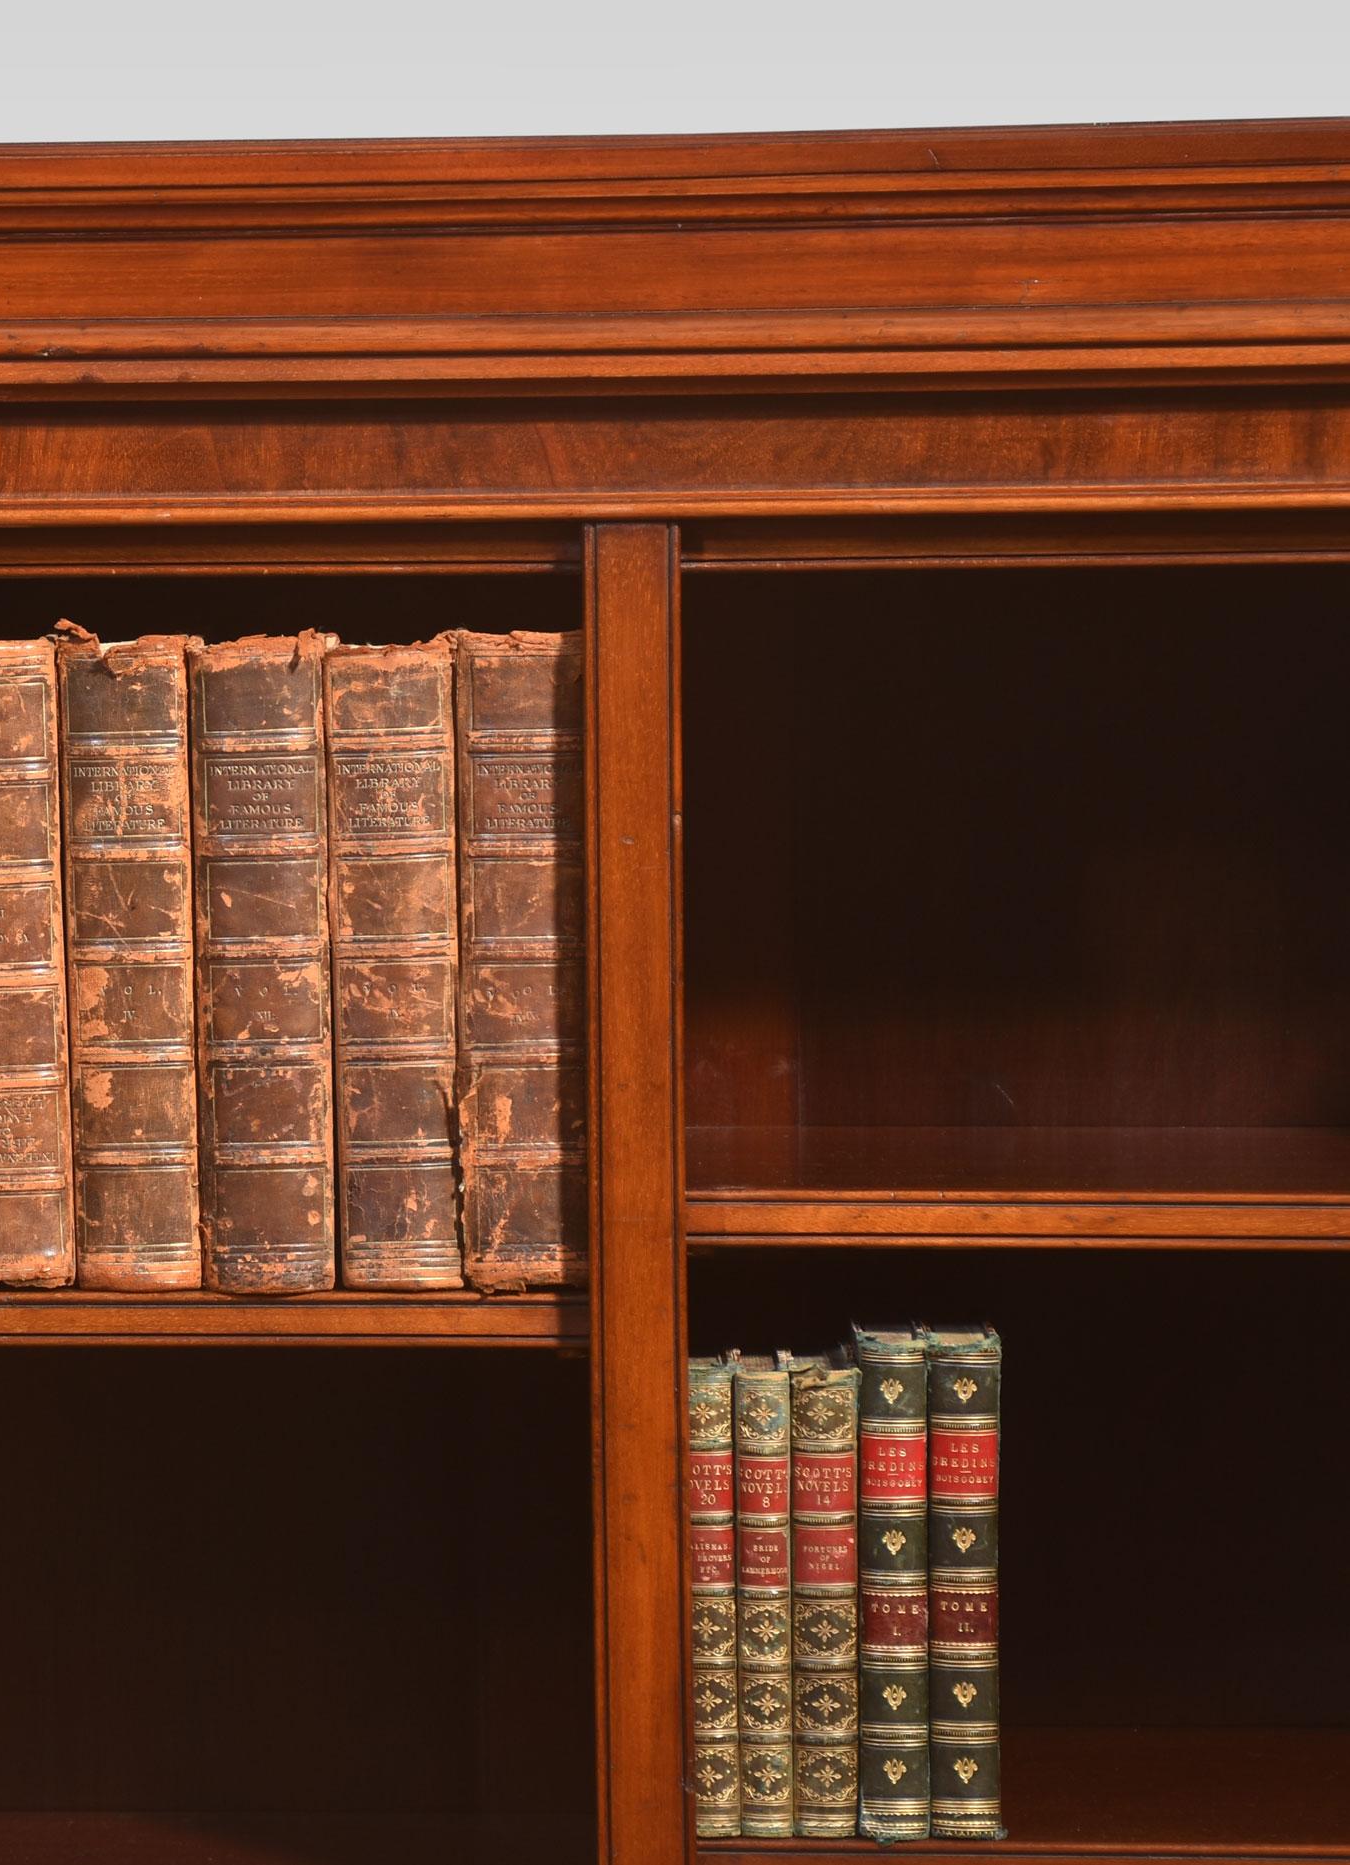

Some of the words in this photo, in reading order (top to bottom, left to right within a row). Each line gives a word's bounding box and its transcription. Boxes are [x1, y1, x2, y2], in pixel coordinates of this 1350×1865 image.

[209, 763, 315, 776] INTERNATIONAL
[336, 761, 441, 776] INTERNATIONAL
[91, 780, 159, 792] LIBRARY
[227, 779, 296, 791] LIBRARY
[354, 777, 422, 789] LIBRARY
[252, 792, 270, 801] OF
[380, 790, 397, 800] OF
[95, 804, 154, 816] FAMOUS
[228, 803, 292, 815] FAMOUS
[359, 801, 419, 814] FAMOUS
[497, 802, 559, 815] FAMOUS
[83, 818, 166, 831] LITERATURE
[218, 817, 304, 830] LITERATURE
[348, 815, 431, 829] LITERATURE
[878, 1446, 907, 1458] LES
[950, 1442, 980, 1454] LES
[794, 1466, 852, 1480] SCOTT'S
[797, 1480, 850, 1494] NOVELS
[700, 1493, 717, 1506] 20
[761, 1496, 771, 1509] 8
[816, 1494, 832, 1506] 14
[752, 1544, 779, 1553] BRIDE
[803, 1545, 849, 1555] FORTUNES
[759, 1556, 771, 1565] OF
[819, 1555, 830, 1563] OF
[871, 1603, 919, 1615] TOME
[940, 1601, 989, 1613] TOME
[957, 1622, 975, 1634] II.
